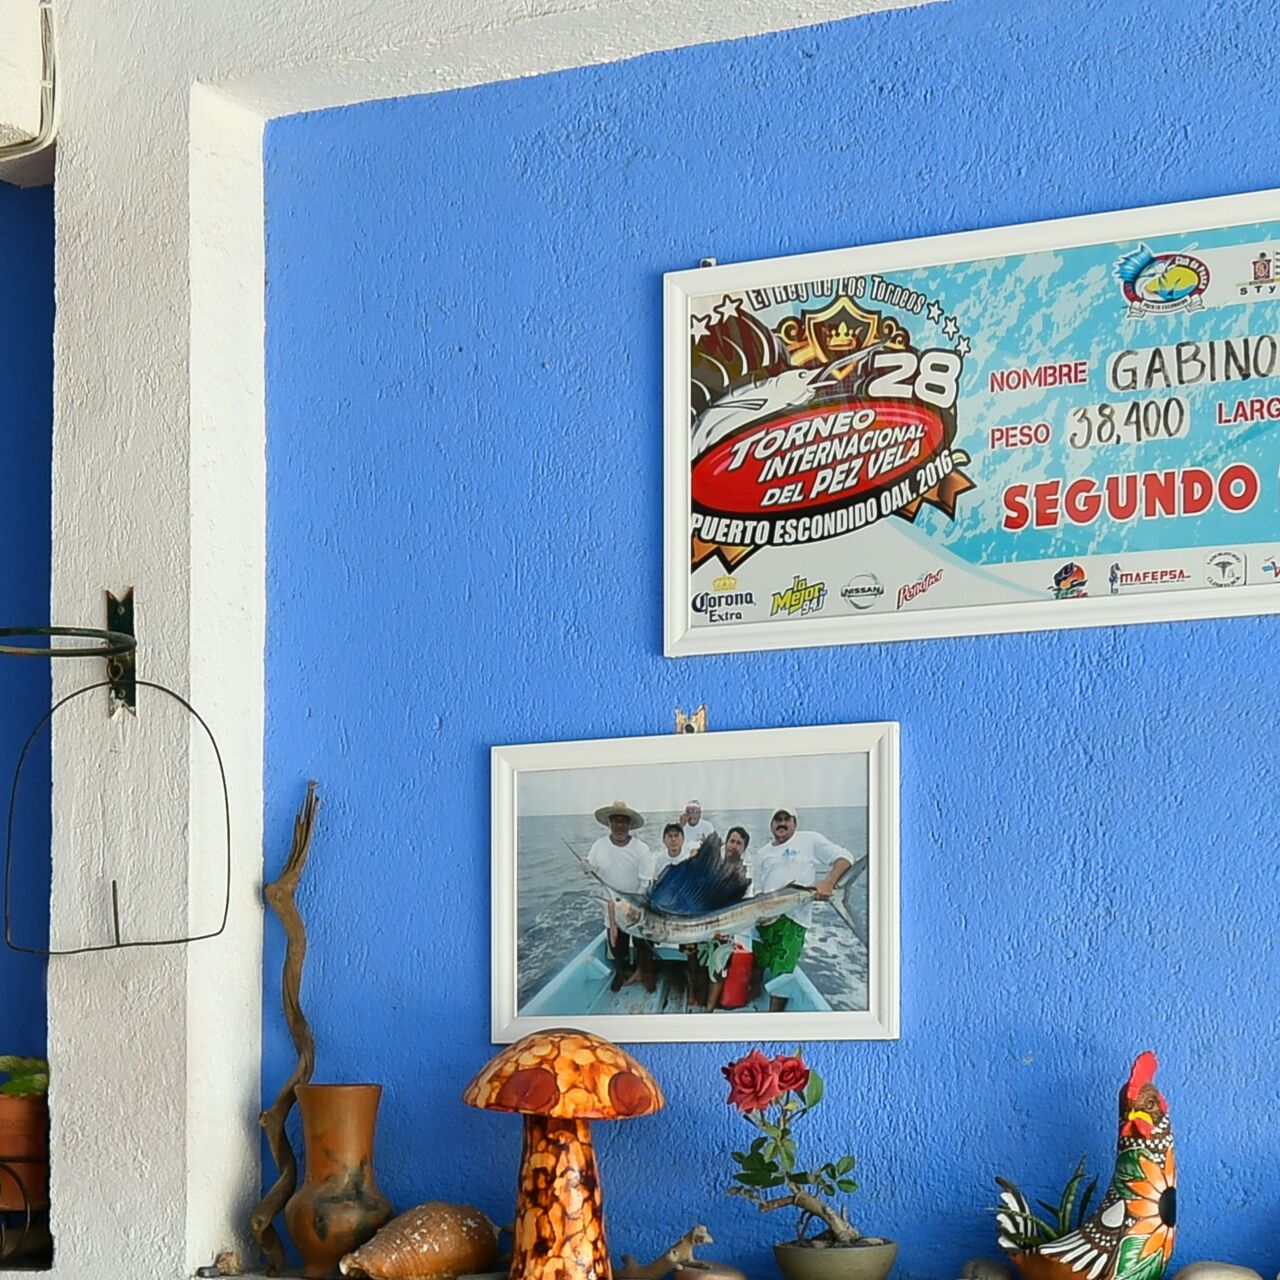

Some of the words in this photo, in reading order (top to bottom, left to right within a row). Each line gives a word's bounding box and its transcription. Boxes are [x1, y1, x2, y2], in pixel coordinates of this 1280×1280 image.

[749, 287, 769, 310] El
[838, 276, 865, 297] Los
[871, 276, 927, 315] Torneos
[867, 350, 963, 409] 28
[990, 362, 1087, 392] NOMBRE
[1111, 334, 1278, 391] GABINO
[728, 409, 876, 471] TORNEO
[990, 423, 1051, 449] PESO
[1069, 397, 1186, 450] 38,400
[758, 424, 926, 483] INTERNACIONAL
[760, 482, 805, 506] DEL
[809, 456, 864, 499] PEZ
[868, 440, 920, 480] VELA
[691, 513, 769, 545] PUERTO
[773, 499, 877, 544] ESCONDIDO
[880, 484, 917, 516] OAX.
[919, 450, 954, 495] 2016
[1002, 464, 1258, 531] SEGUNDO
[770, 582, 825, 616] Mejor
[843, 586, 882, 596] NISSAN
[1120, 569, 1186, 584] MAFEPSA
[691, 591, 754, 614] Corona
[709, 610, 743, 622] Extra
